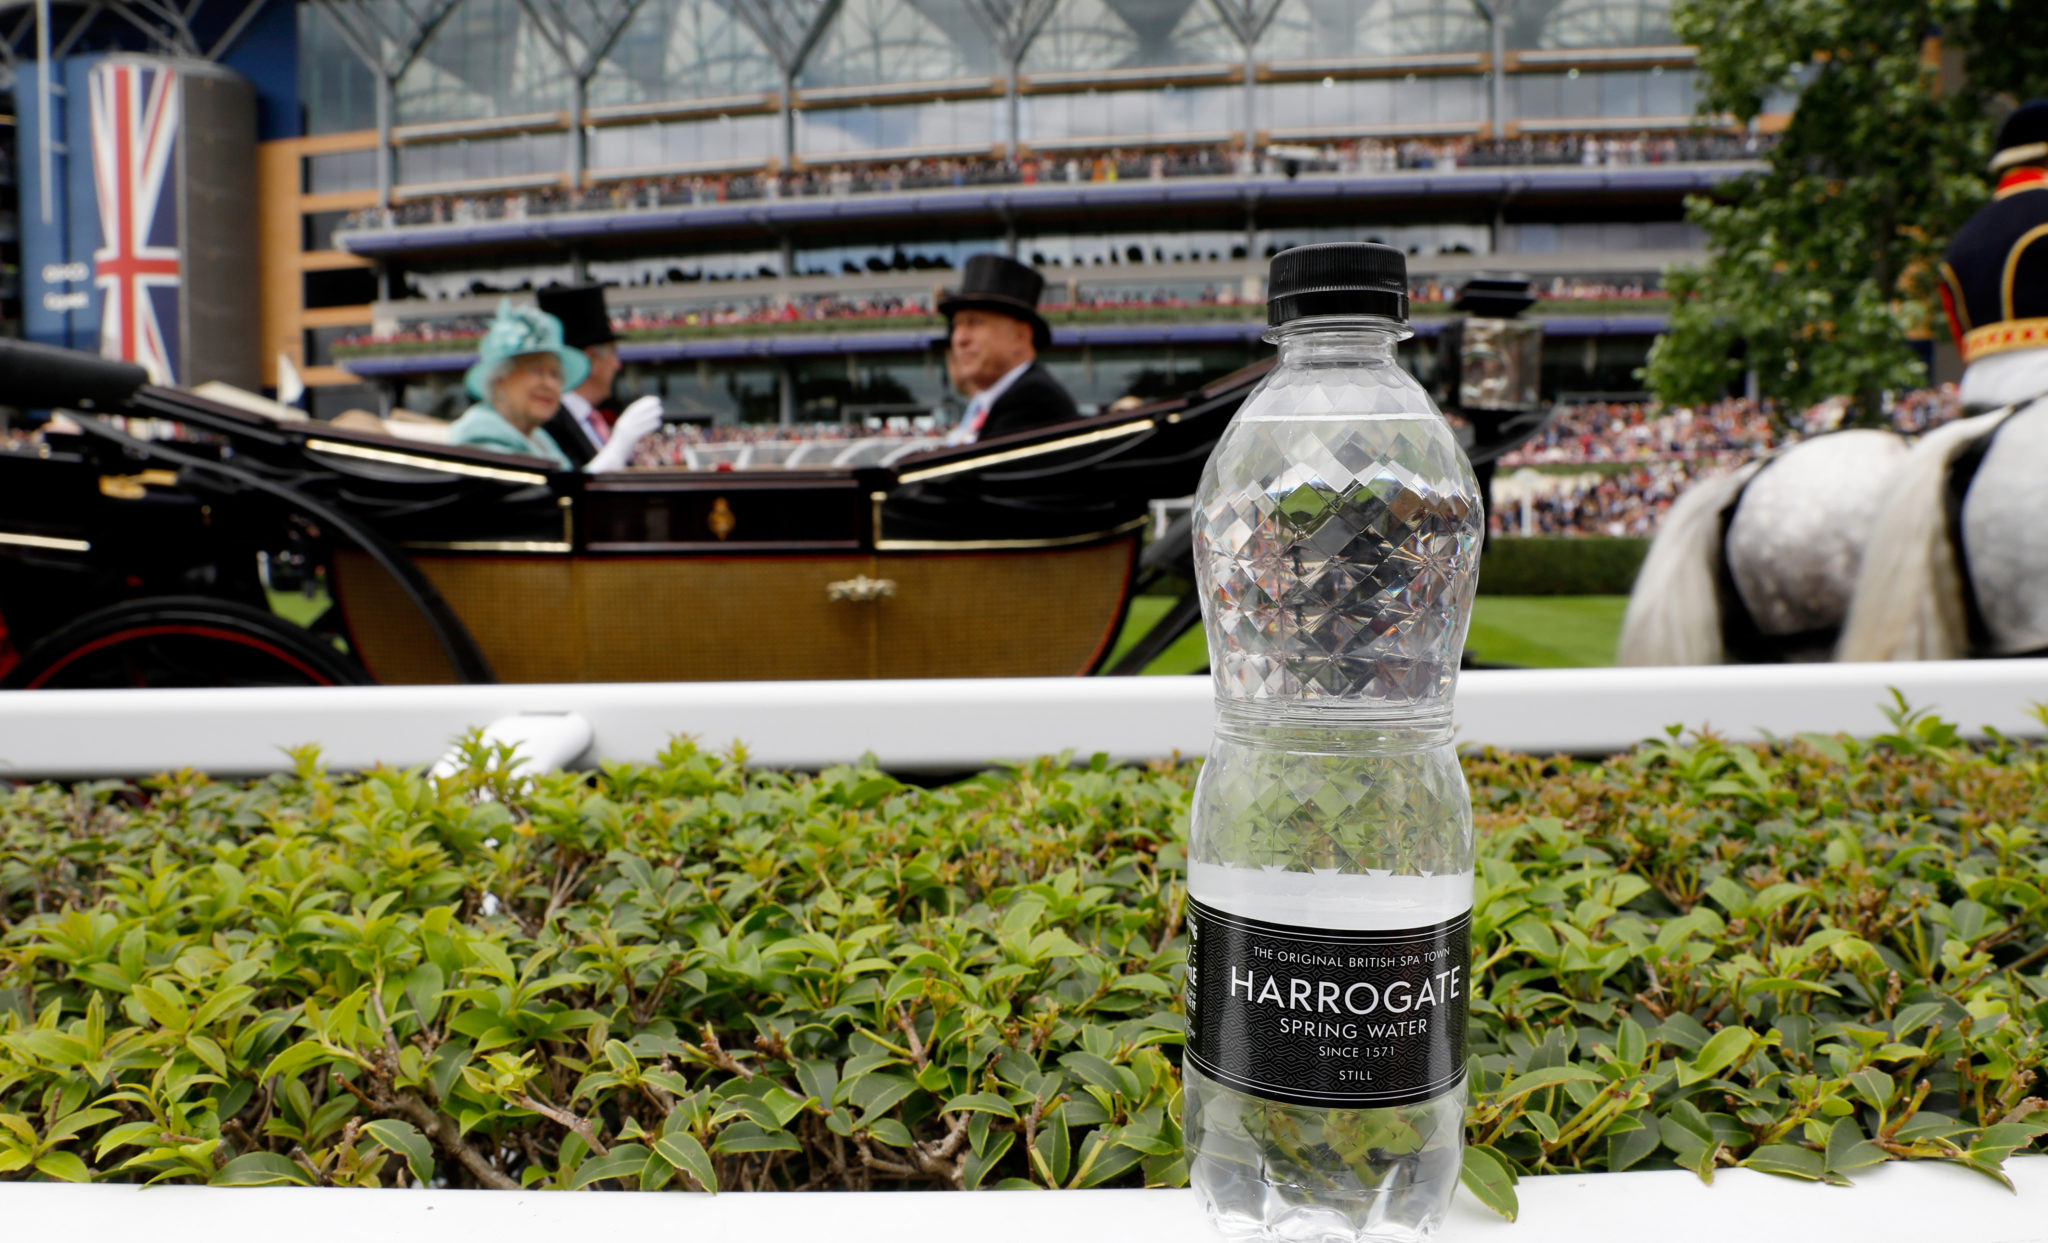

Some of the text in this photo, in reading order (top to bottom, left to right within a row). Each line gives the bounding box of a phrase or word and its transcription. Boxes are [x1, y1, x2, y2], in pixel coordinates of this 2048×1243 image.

[1254, 947, 1450, 968] THE ORIGINAL BRITISH SPA TOWN
[1231, 965, 1460, 1015] HARROGATE
[1280, 1018, 1427, 1039] SPRING WATER
[1319, 1046, 1395, 1058] SINCE 1571
[1339, 1070, 1373, 1081] STILL
